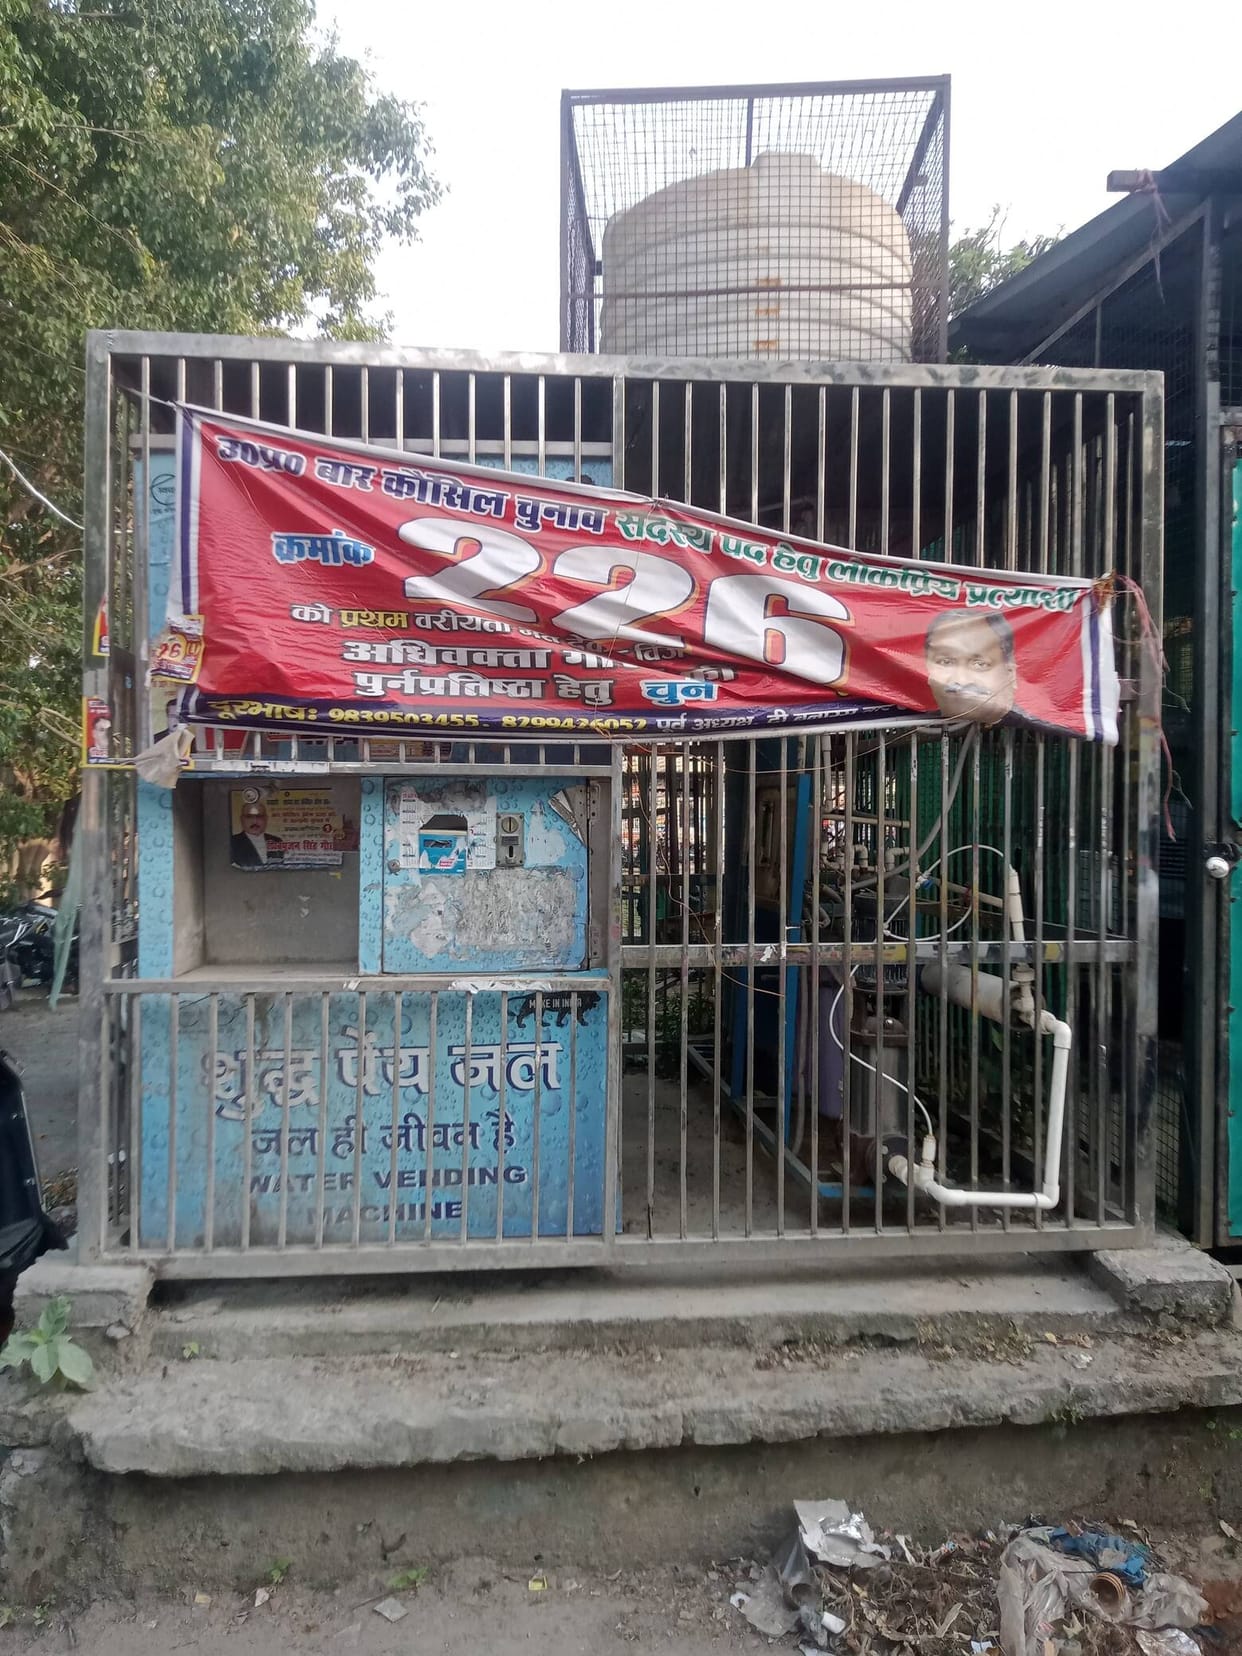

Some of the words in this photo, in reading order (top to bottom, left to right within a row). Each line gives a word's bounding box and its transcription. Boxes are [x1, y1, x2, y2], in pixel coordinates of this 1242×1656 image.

[315, 457, 378, 493] बार
[513, 493, 610, 536] चुनाव
[614, 510, 718, 553] सदस्य
[718, 533, 769, 567] पद
[772, 541, 822, 583] हेतु
[270, 529, 376, 567] क्रमांक
[290, 603, 335, 625] को
[339, 609, 410, 629] प्रथम
[414, 611, 512, 633] वरीयता
[398, 516, 853, 687] 226
[341, 639, 553, 670] अधिवक्ता
[551, 673, 616, 707] हेतु
[529, 999, 551, 1009] MKE
[552, 998, 560, 1008] IN
[562, 998, 582, 1008] INA
[448, 1041, 563, 1092] जल
[250, 1128, 318, 1157] जल
[331, 1114, 368, 1161] ही
[380, 1112, 481, 1153] जीवन
[485, 1109, 516, 1155] है
[241, 1171, 357, 1194] WATER
[372, 1165, 529, 1189] VENDING
[306, 1200, 463, 1226] MACHINE
